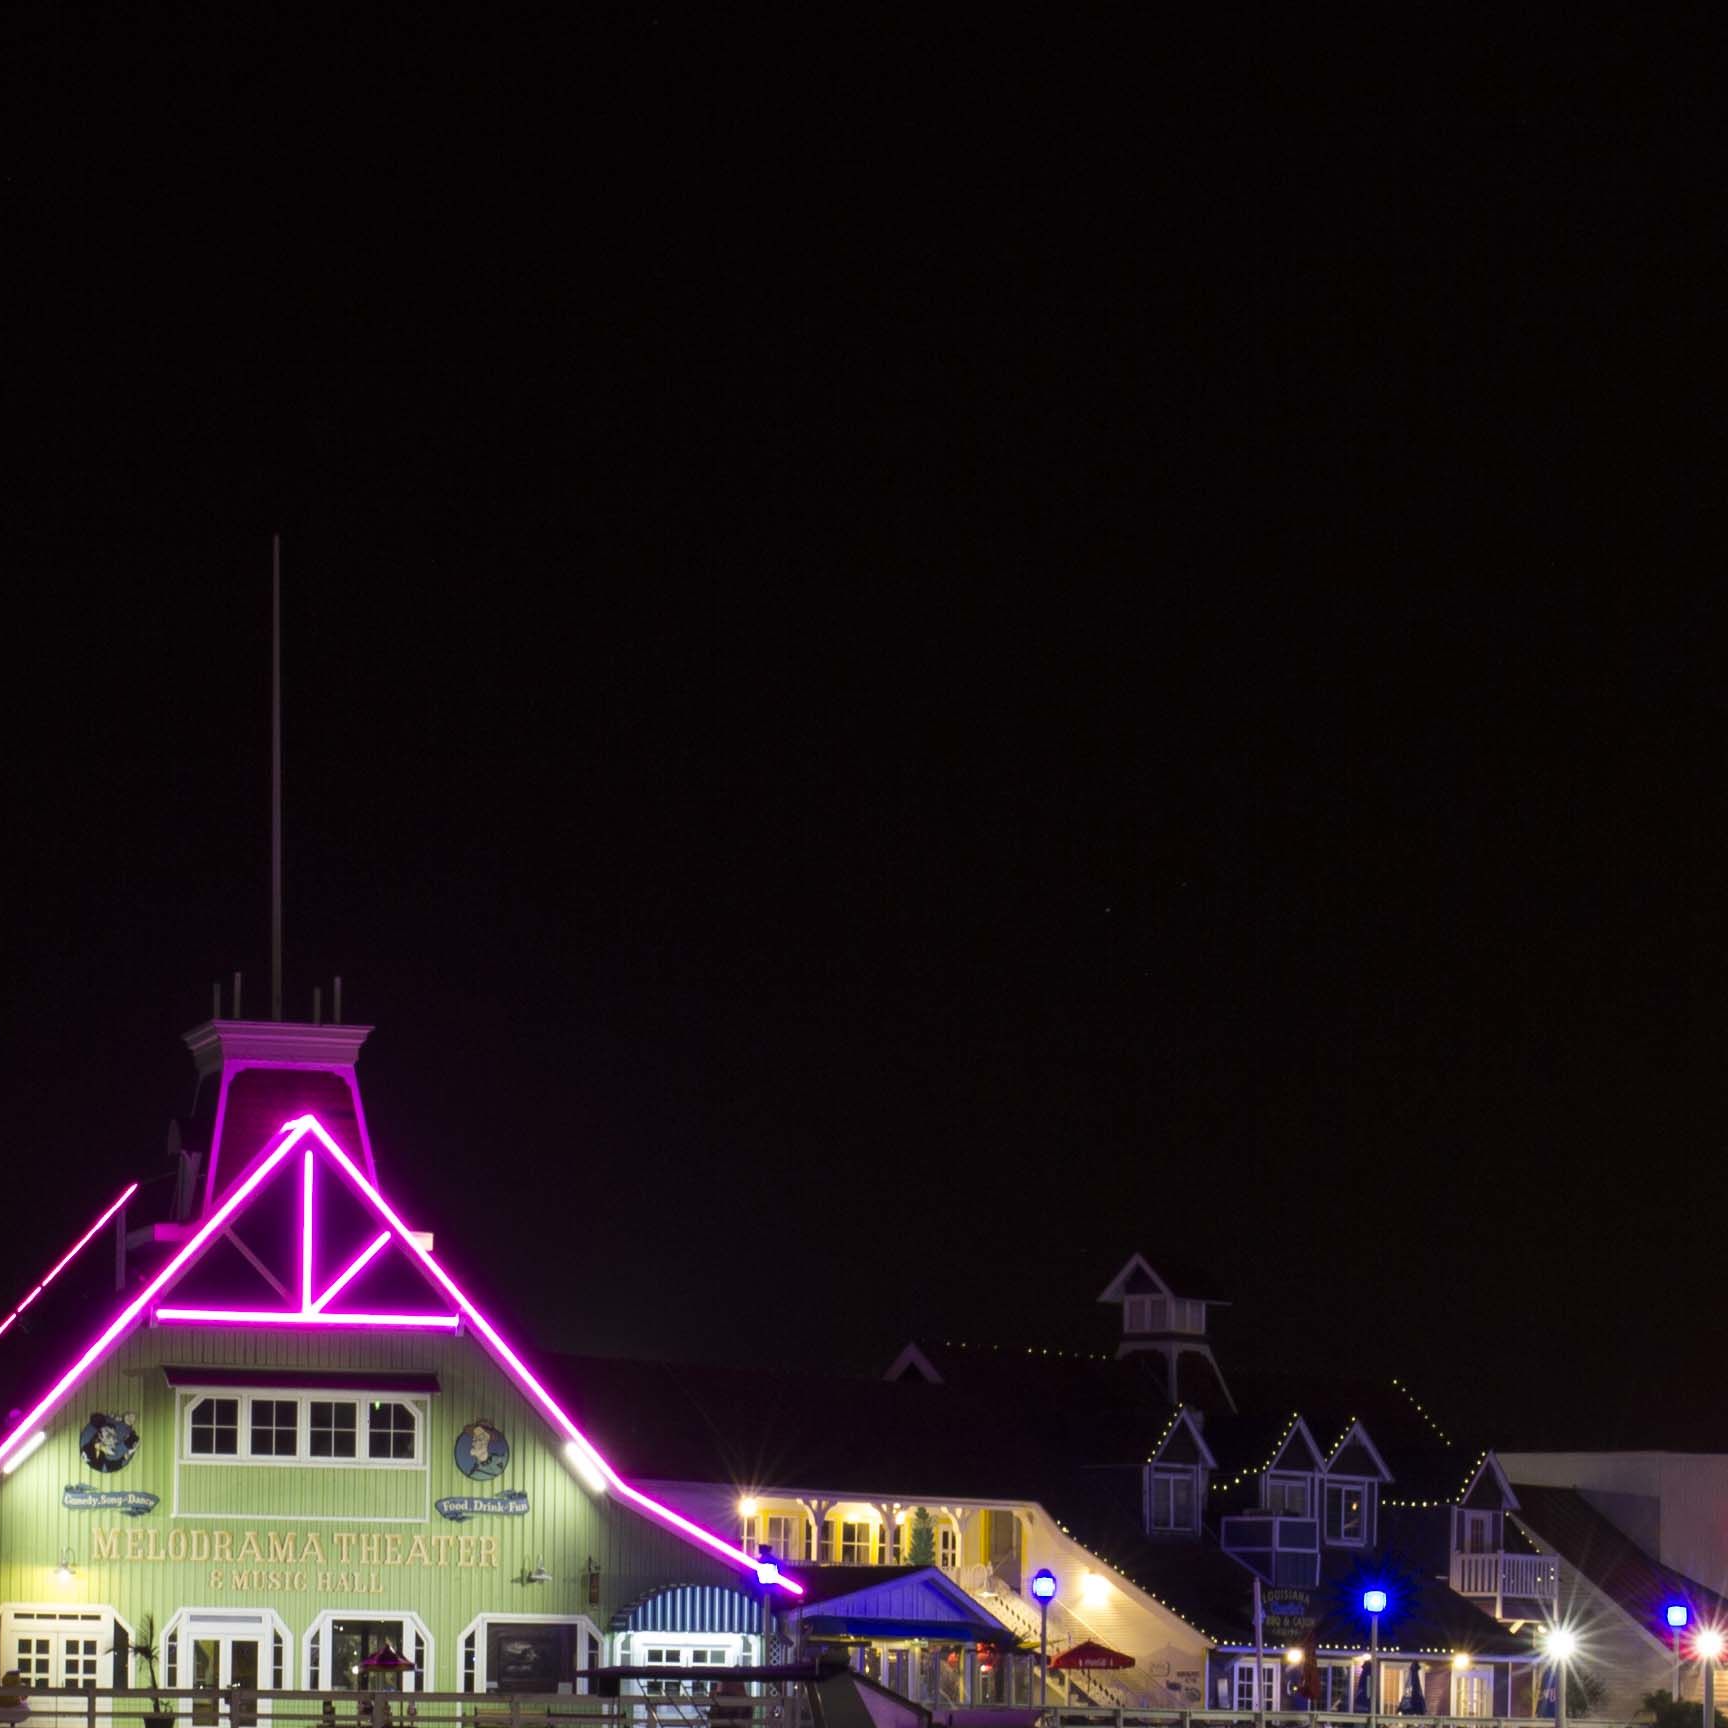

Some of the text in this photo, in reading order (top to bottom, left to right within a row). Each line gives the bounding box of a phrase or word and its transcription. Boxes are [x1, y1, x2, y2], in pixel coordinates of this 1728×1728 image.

[92, 1528, 499, 1569] MELODRAMA THEATER
[208, 1569, 384, 1594] & MUSIC HALL
